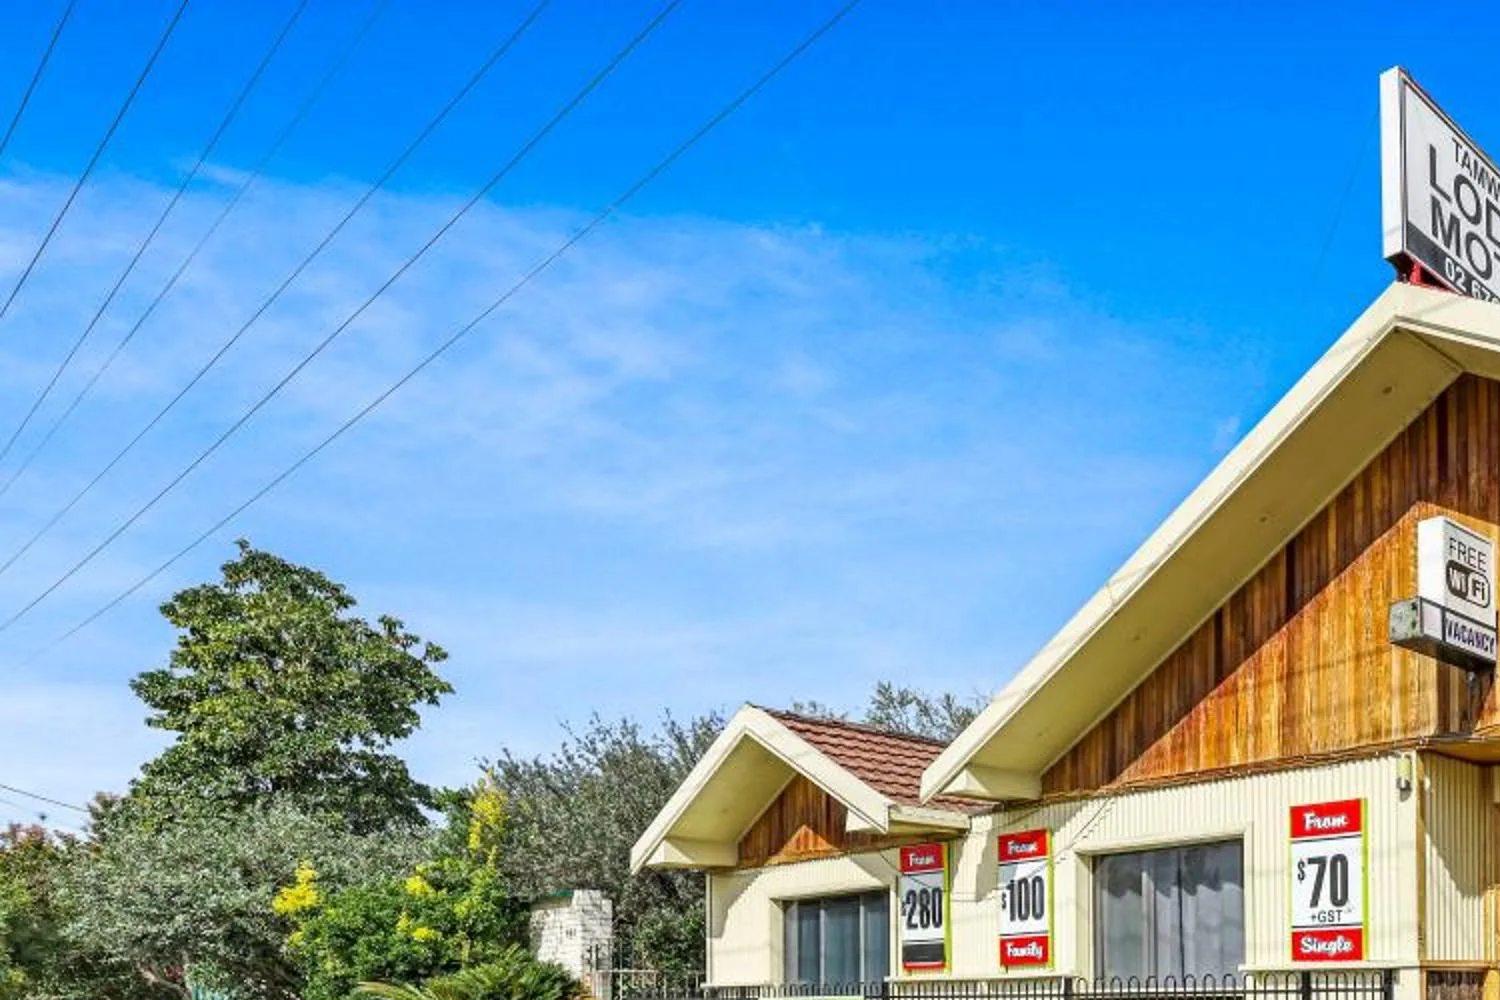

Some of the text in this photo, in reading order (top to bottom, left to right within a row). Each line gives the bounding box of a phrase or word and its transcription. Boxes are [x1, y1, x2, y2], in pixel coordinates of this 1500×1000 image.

[1449, 537, 1487, 573] FREE
[1446, 618, 1495, 653] VACANCY
[1303, 811, 1348, 831] From
[1008, 840, 1038, 855] From
[909, 852, 936, 867] From
[1297, 854, 1348, 908] $70
[1001, 875, 1044, 922] $100
[1311, 909, 1343, 922] +GST
[1006, 941, 1043, 959] Family
[1301, 935, 1354, 957] Single
